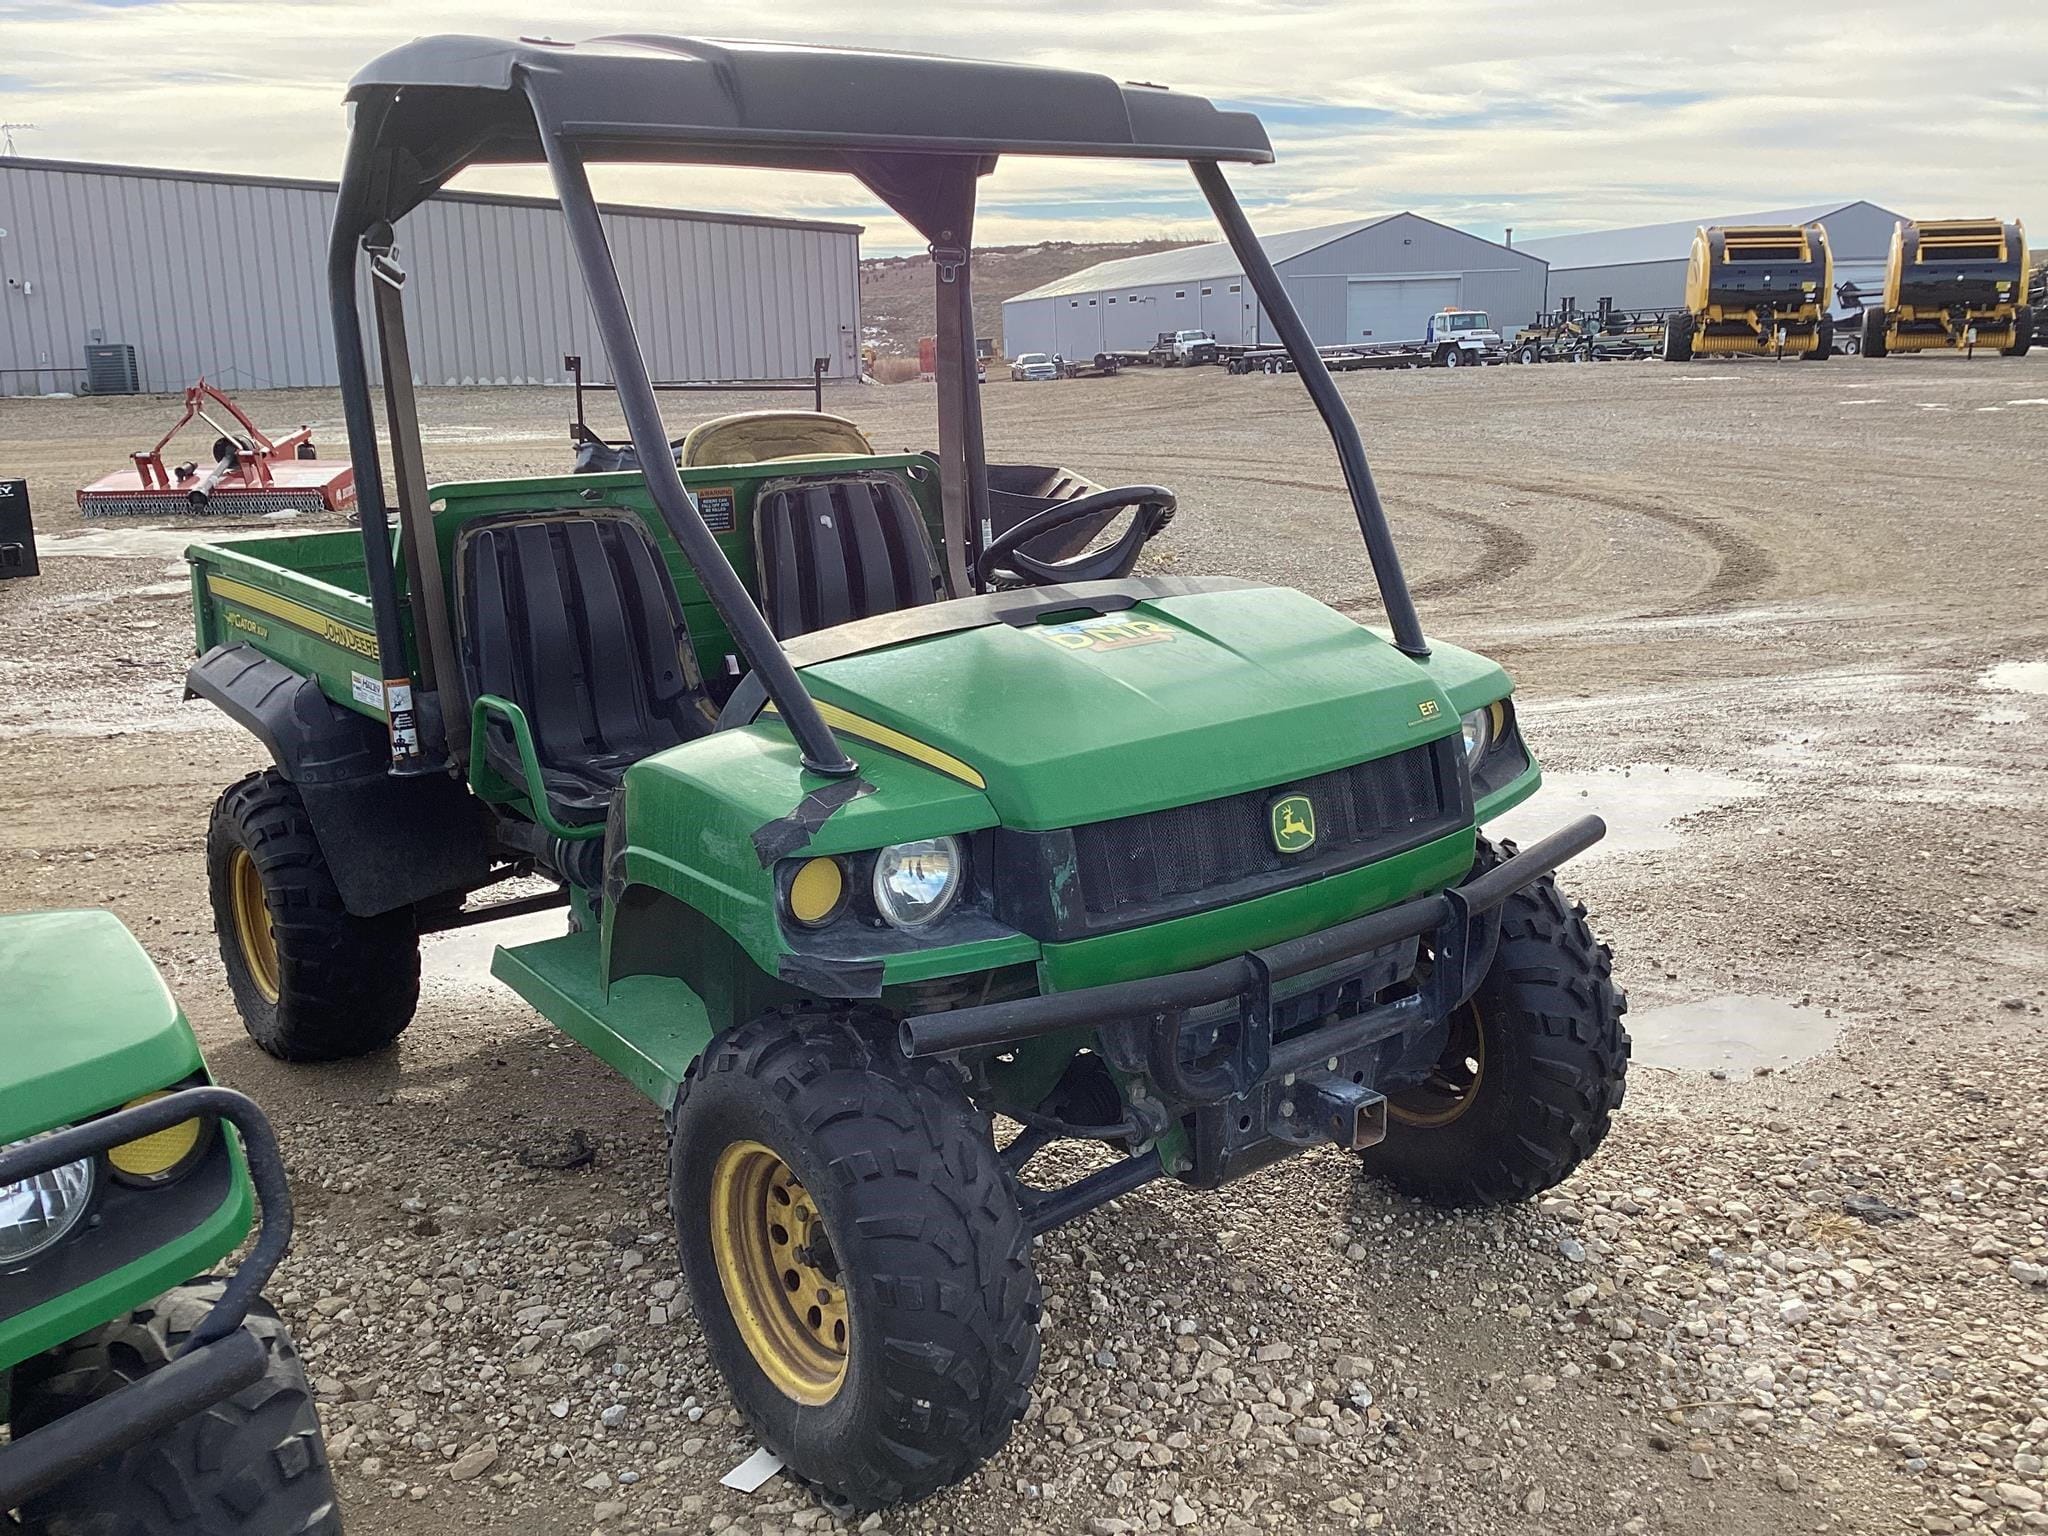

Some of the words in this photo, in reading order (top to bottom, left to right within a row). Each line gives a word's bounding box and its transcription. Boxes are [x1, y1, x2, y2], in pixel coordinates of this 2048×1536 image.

[704, 488, 732, 496] WARNING
[234, 614, 257, 634] GATOR
[323, 619, 348, 646] JOHN
[346, 630, 380, 660] DEERE
[1418, 700, 1440, 716] EFI
